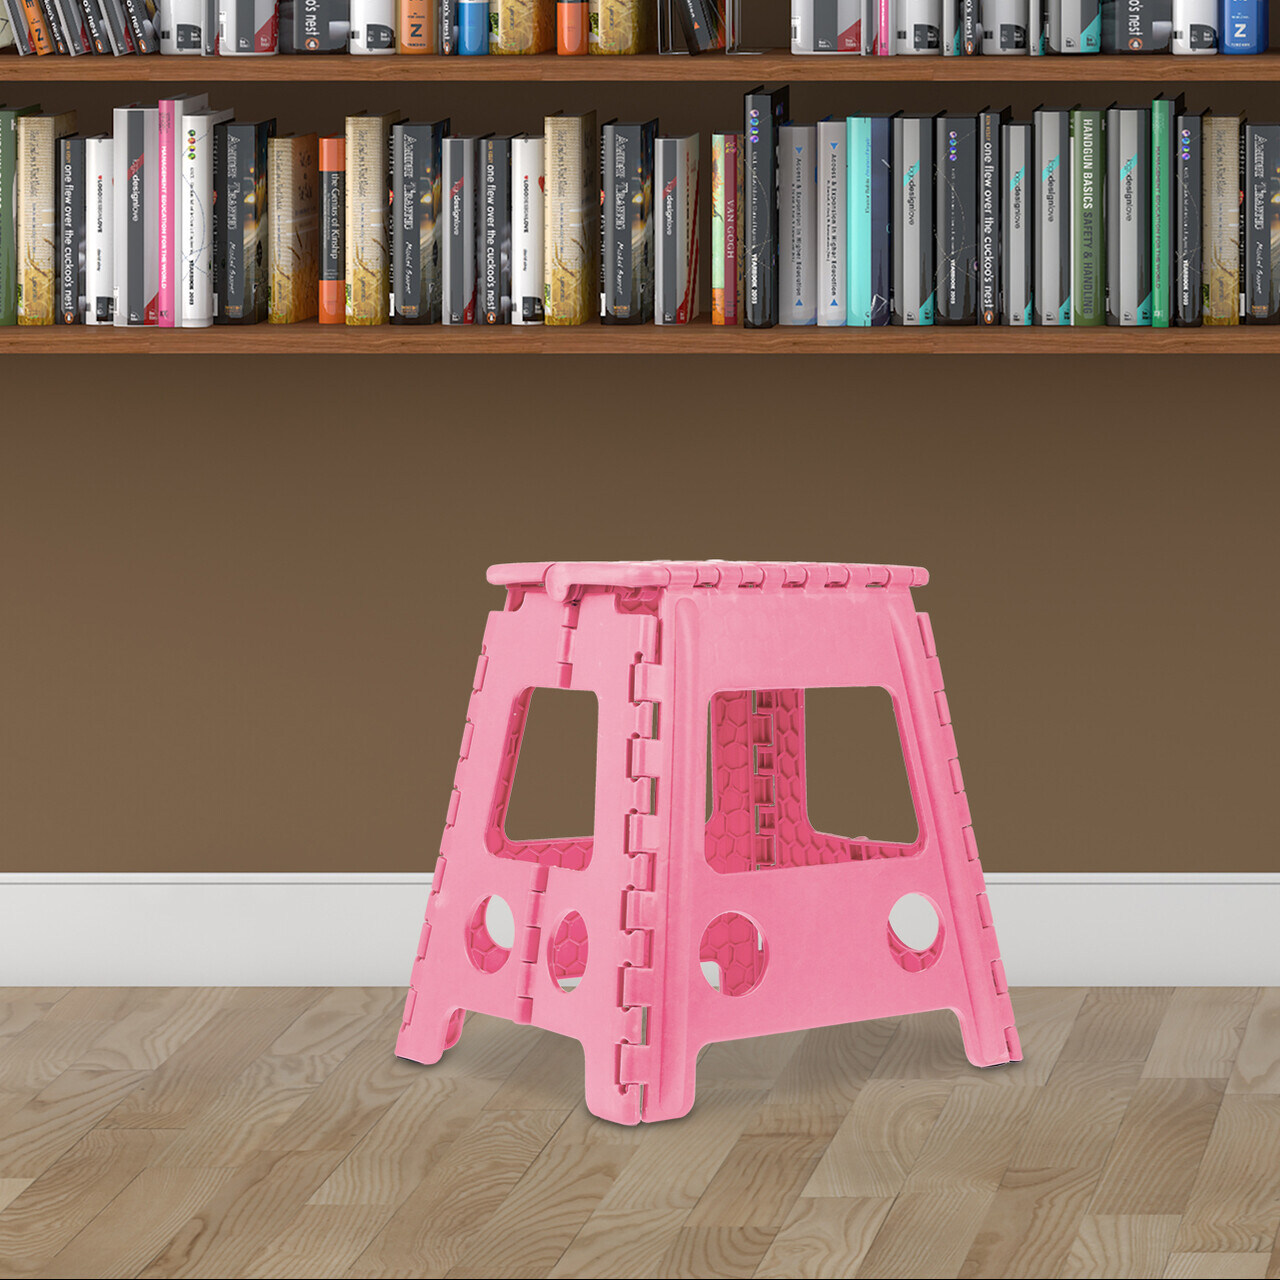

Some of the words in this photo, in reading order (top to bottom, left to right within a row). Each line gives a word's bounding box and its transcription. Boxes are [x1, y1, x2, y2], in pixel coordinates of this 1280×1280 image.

[131, 15, 143, 38] nest
[305, 15, 319, 35] nest
[1083, 119, 1092, 168] HANDGUN
[65, 185, 74, 204] flew
[1083, 173, 1092, 209] BASICS
[65, 230, 73, 244] the
[1084, 212, 1092, 248] SAFETY
[65, 247, 74, 287] cuckoo's
[65, 290, 73, 309] nest
[1083, 263, 1093, 314] HANDLING
